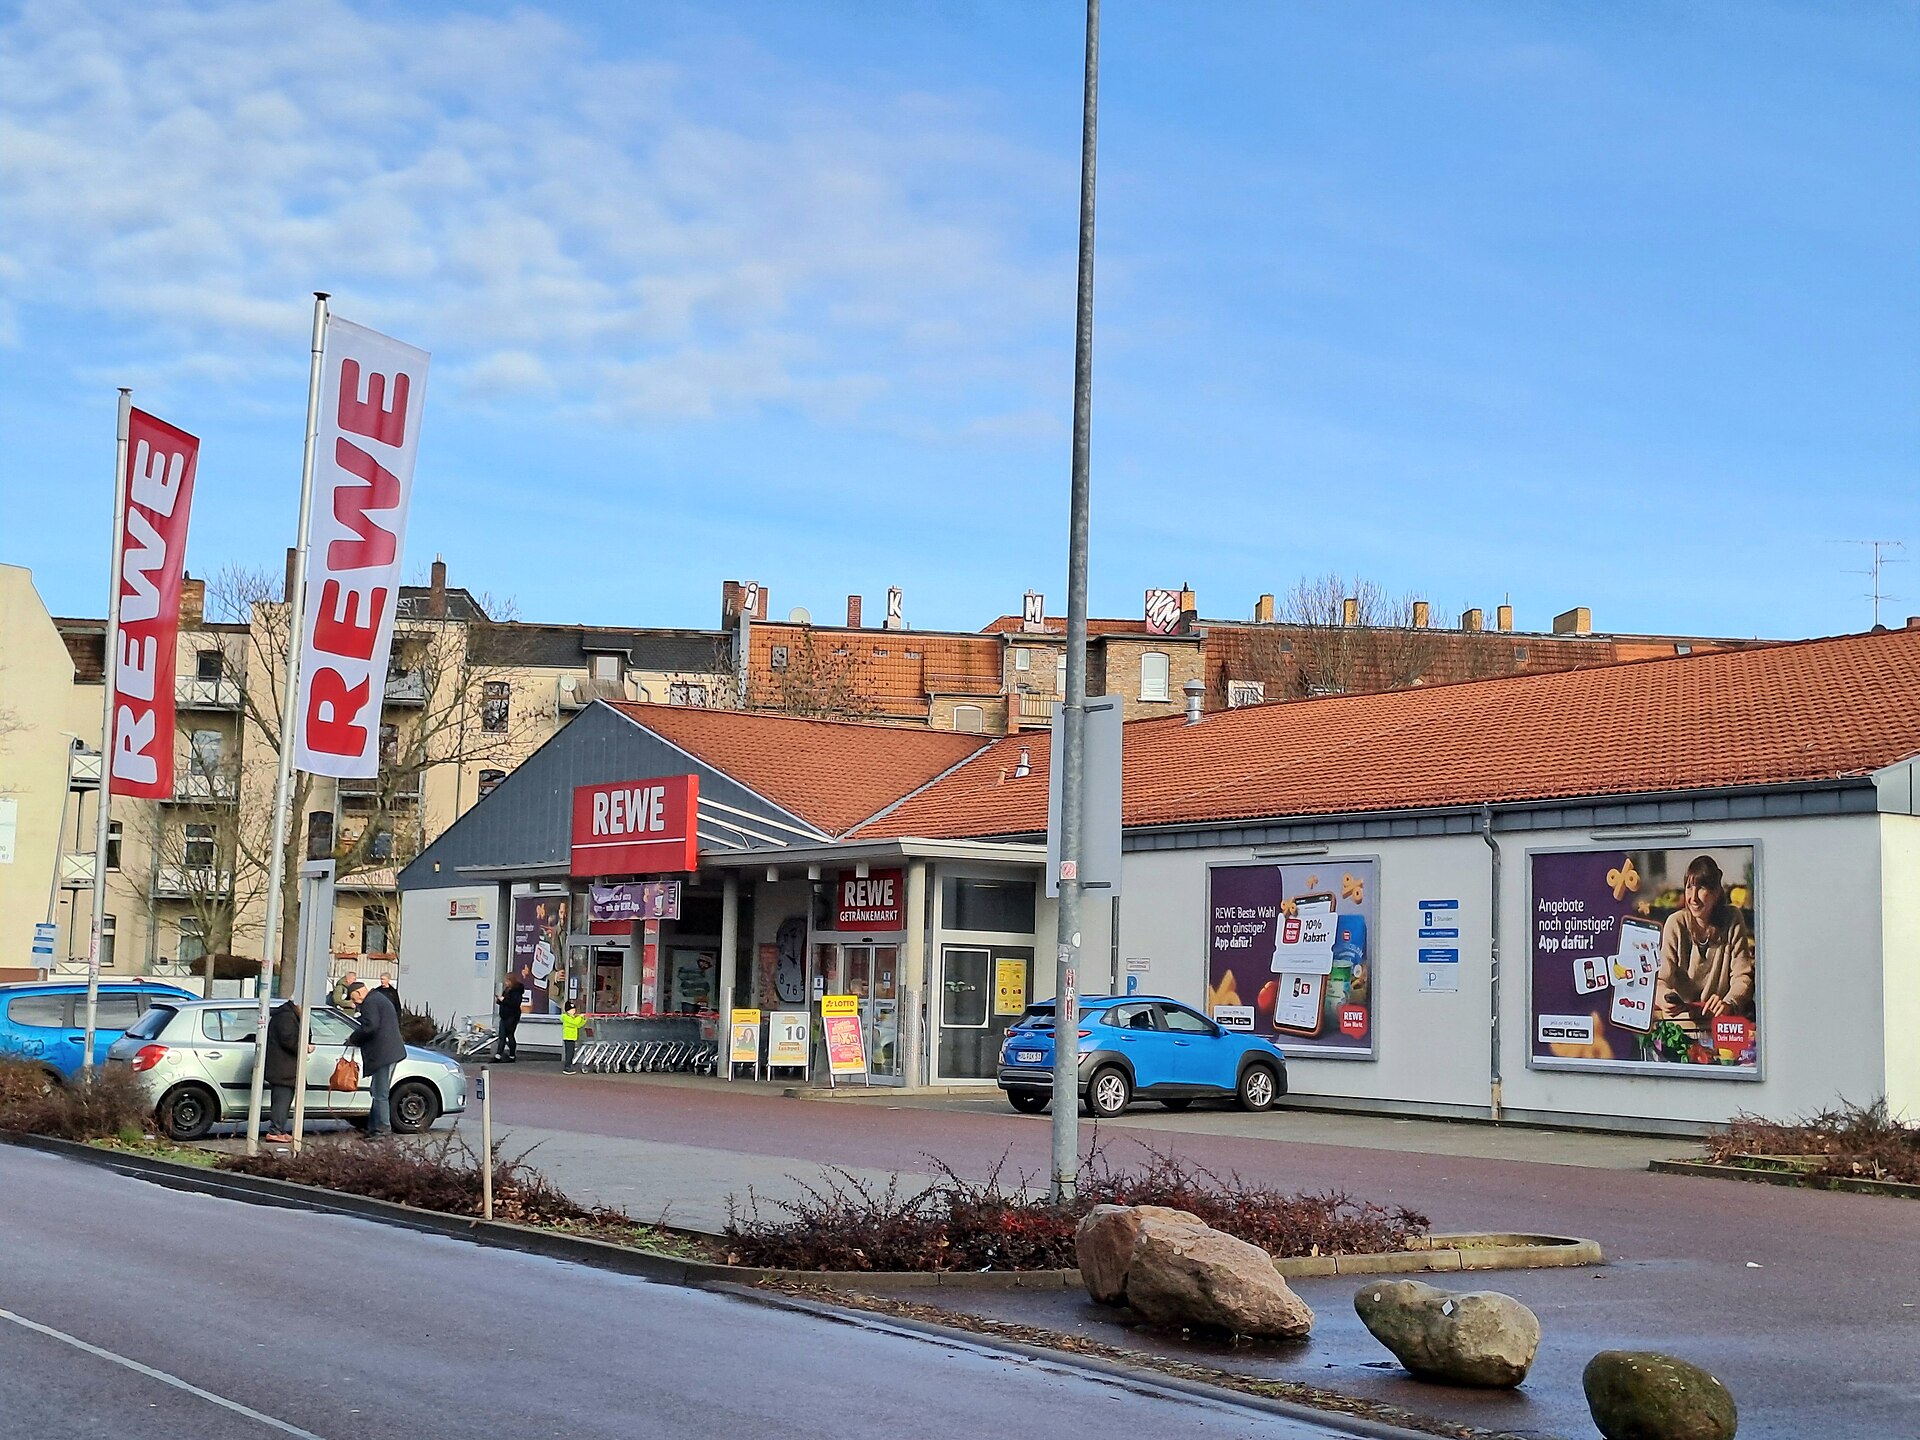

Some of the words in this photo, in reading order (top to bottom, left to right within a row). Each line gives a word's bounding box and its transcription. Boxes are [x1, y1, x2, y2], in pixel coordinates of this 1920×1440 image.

[306, 358, 410, 757] REWE
[112, 438, 185, 785] REWE
[888, 589, 902, 618] K
[1025, 595, 1043, 623] M
[592, 786, 665, 836] REWE
[844, 879, 894, 907] REWE
[1215, 907, 1236, 919] REWE
[1237, 907, 1256, 918] Beste
[1257, 906, 1276, 918] Wahl
[1538, 898, 1584, 916] Angebote
[1215, 922, 1231, 933] noch
[1232, 921, 1267, 936] günstiger?
[1538, 917, 1562, 931] noch
[1565, 916, 1615, 934] günstiger?
[1215, 936, 1229, 950] App
[1230, 936, 1252, 948] dafür!
[1538, 935, 1559, 952] App
[1561, 935, 1594, 950] dafür!
[792, 984, 798, 995] 6
[1344, 1011, 1363, 1020] REWE
[785, 1026, 806, 1040] 10
[1717, 1023, 1743, 1033] REWE
